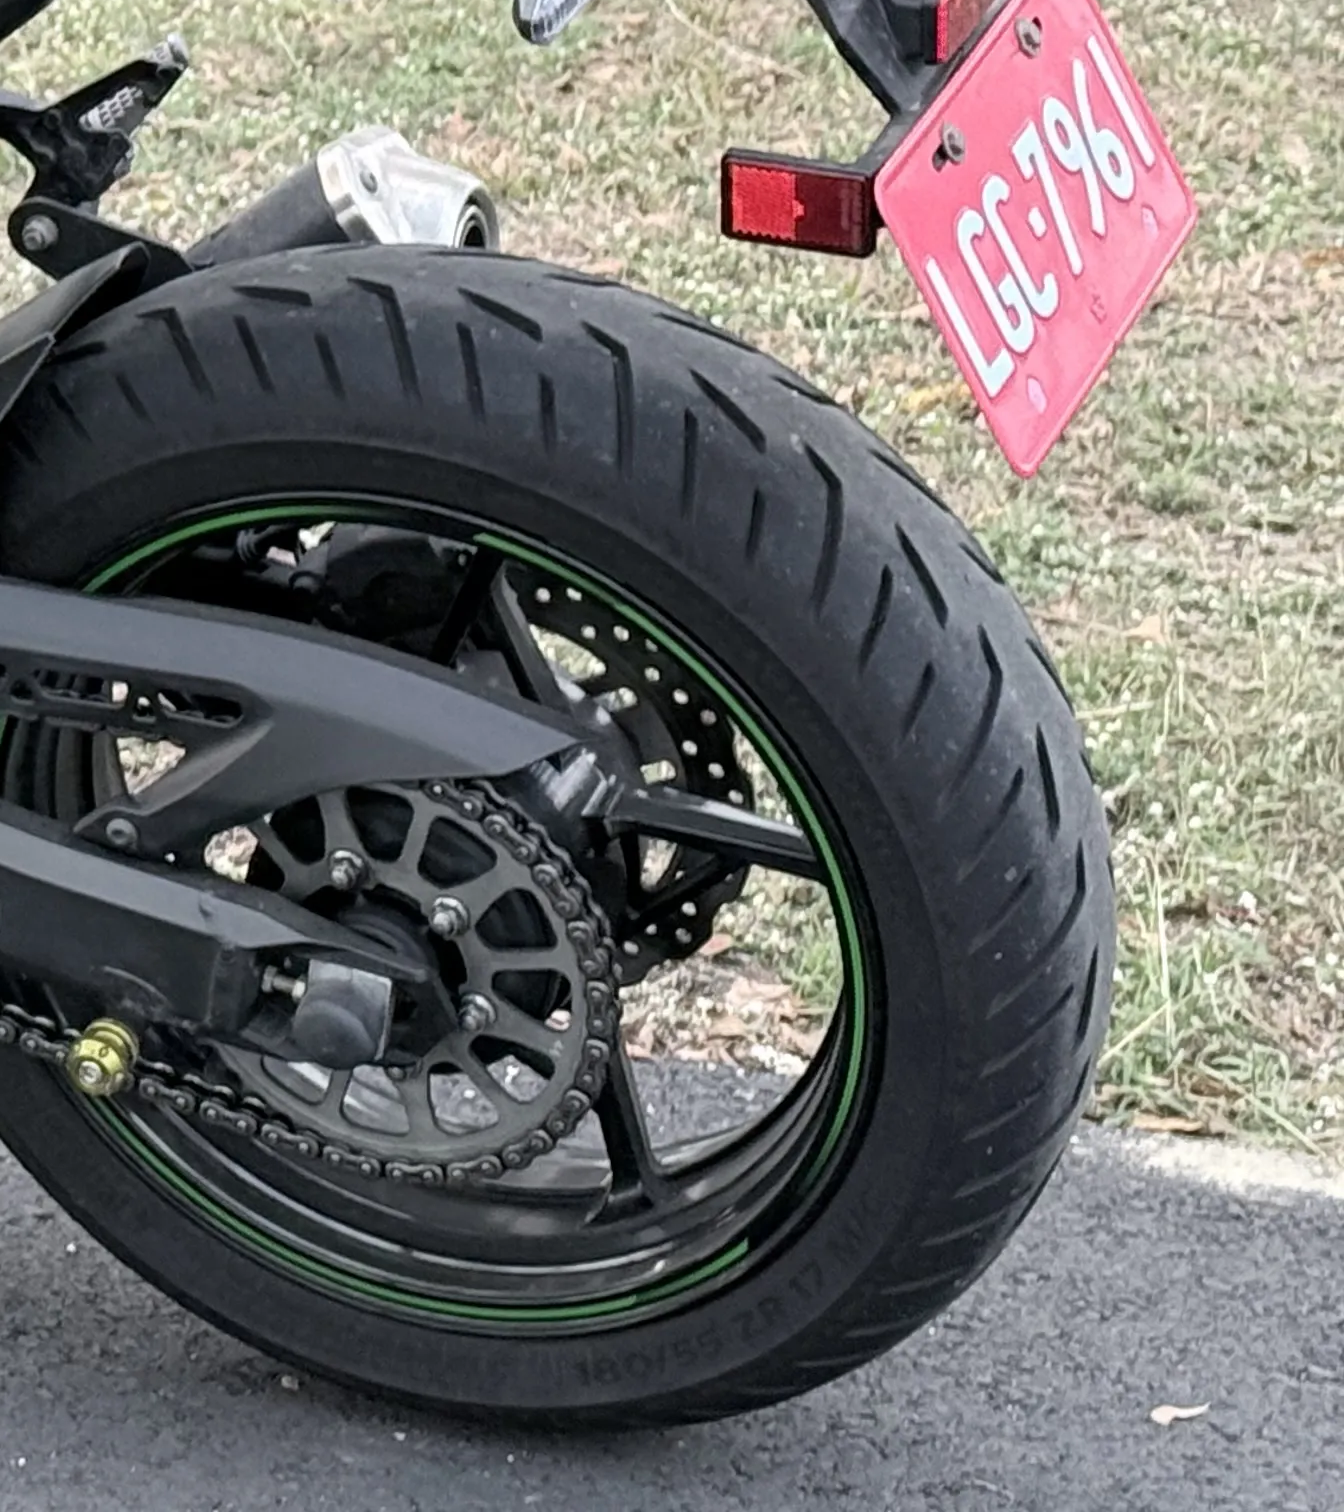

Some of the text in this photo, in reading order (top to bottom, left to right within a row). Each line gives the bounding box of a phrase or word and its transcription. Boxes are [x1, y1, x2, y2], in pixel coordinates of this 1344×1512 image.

[925, 34, 1156, 399] LGC-7961
[578, 1328, 724, 1387] 180/55
[732, 1296, 790, 1342] ZR
[788, 1259, 825, 1300] 17
